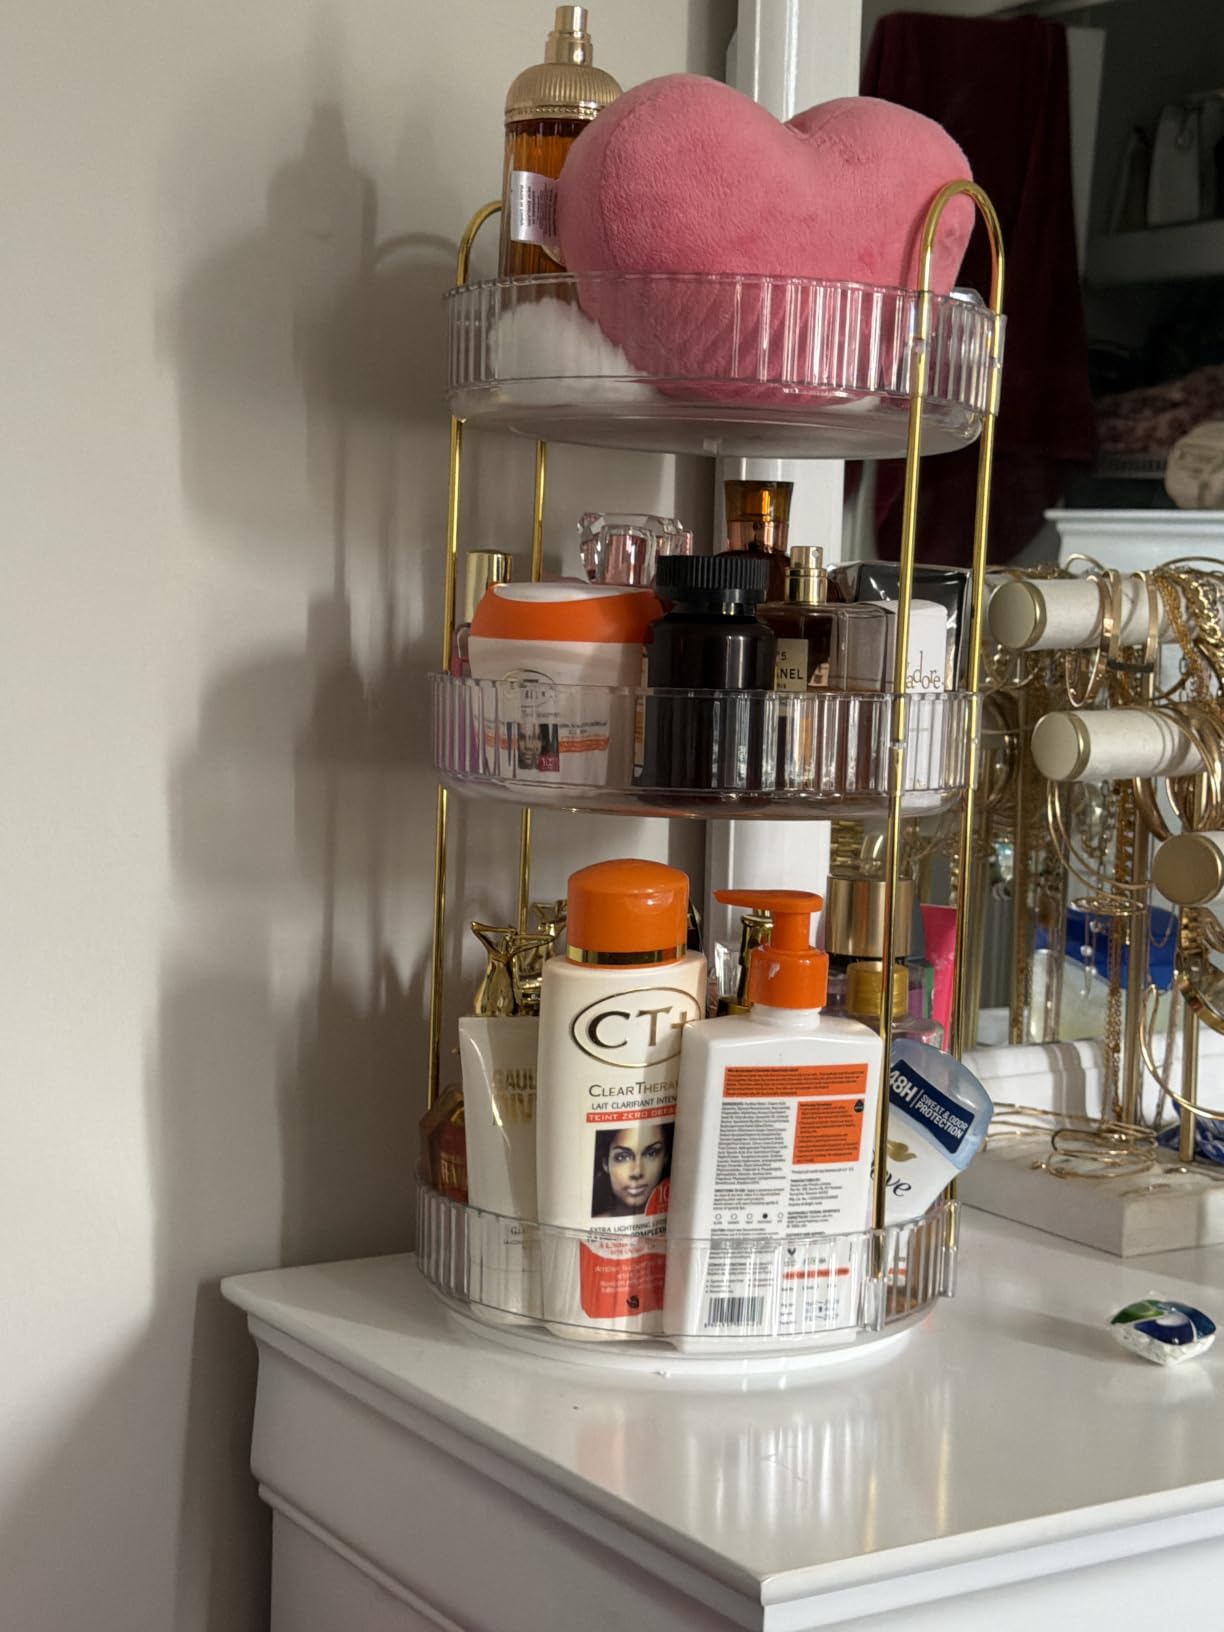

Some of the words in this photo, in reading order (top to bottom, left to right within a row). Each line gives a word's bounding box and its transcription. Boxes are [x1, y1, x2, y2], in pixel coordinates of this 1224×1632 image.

[889, 1070, 918, 1102] 48H
[588, 1113, 619, 1121] TEINT
[622, 1111, 648, 1120] ZERO
[591, 1102, 609, 1111] LAIT
[611, 1098, 654, 1110] CLARIFIANT
[915, 1101, 965, 1139] PROTECTION
[920, 1094, 945, 1115] SWEAT
[942, 1110, 950, 1120] &
[949, 1114, 968, 1131] ODOR
